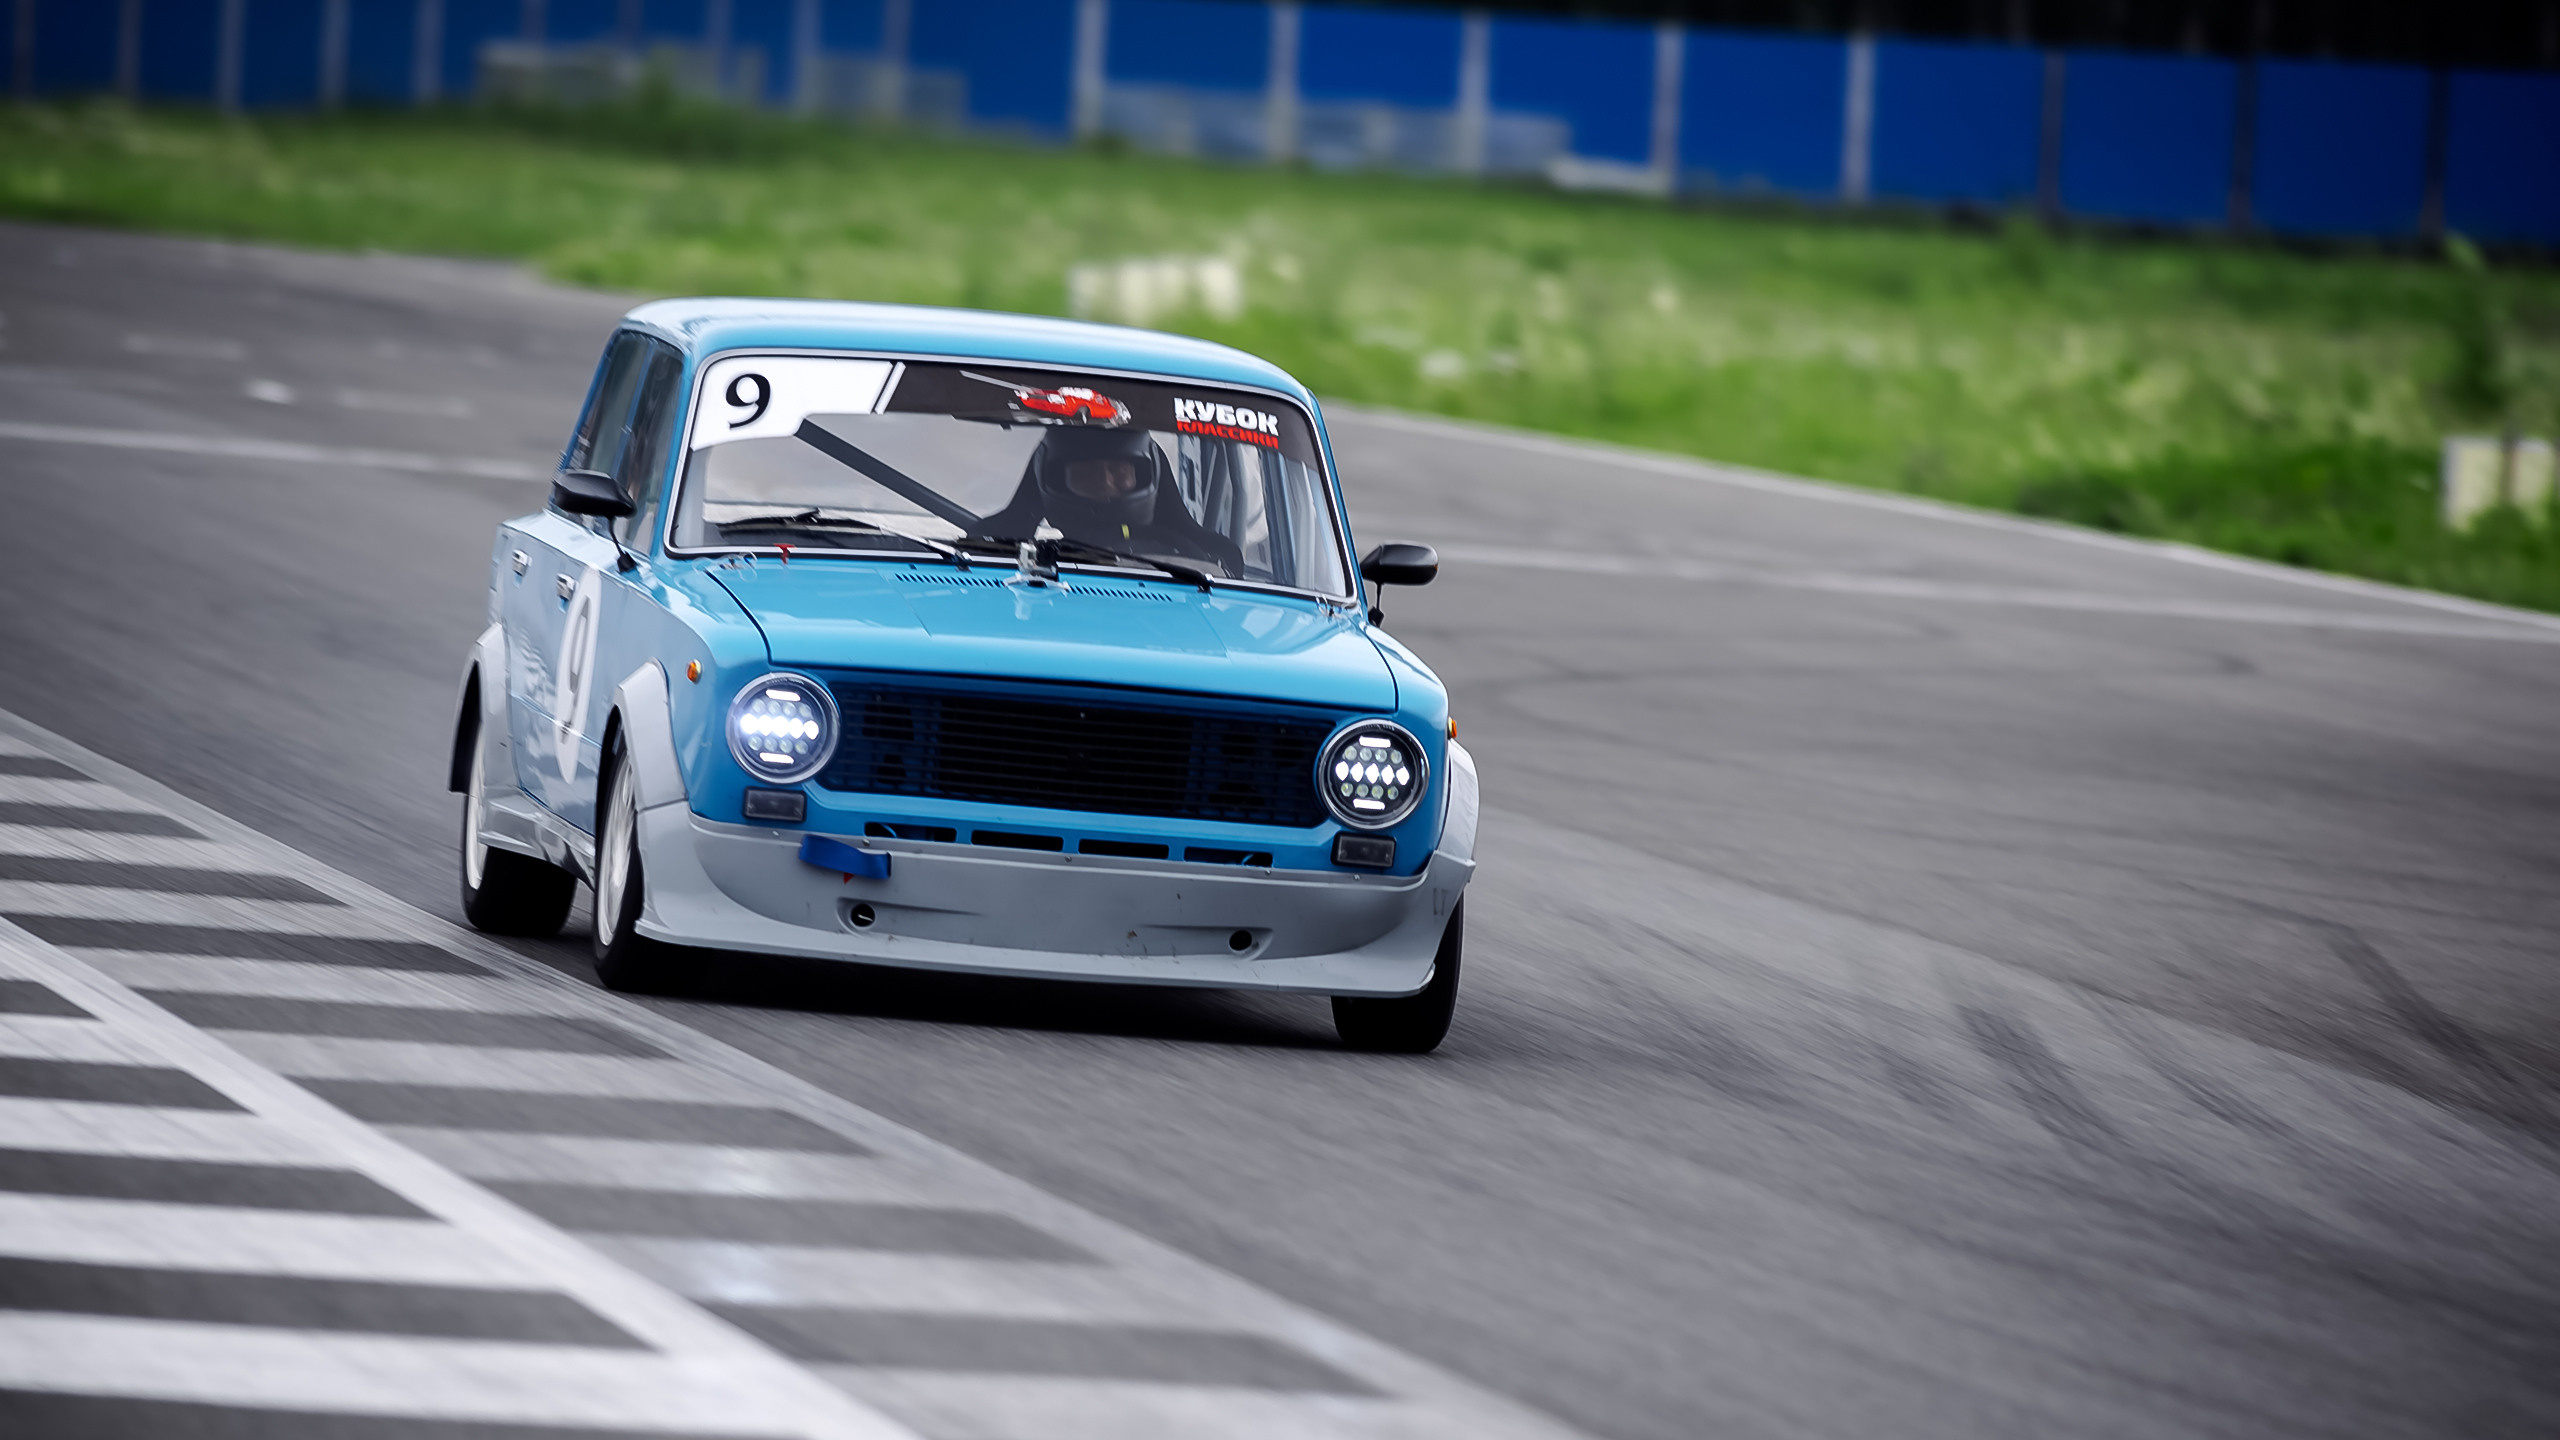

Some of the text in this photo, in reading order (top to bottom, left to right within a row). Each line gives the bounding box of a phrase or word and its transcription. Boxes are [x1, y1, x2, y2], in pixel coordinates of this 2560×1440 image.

[725, 373, 771, 429] 9
[1174, 397, 1279, 436] КУБОК
[1176, 420, 1279, 449] КЛАССИКИ
[559, 594, 591, 744] 9
